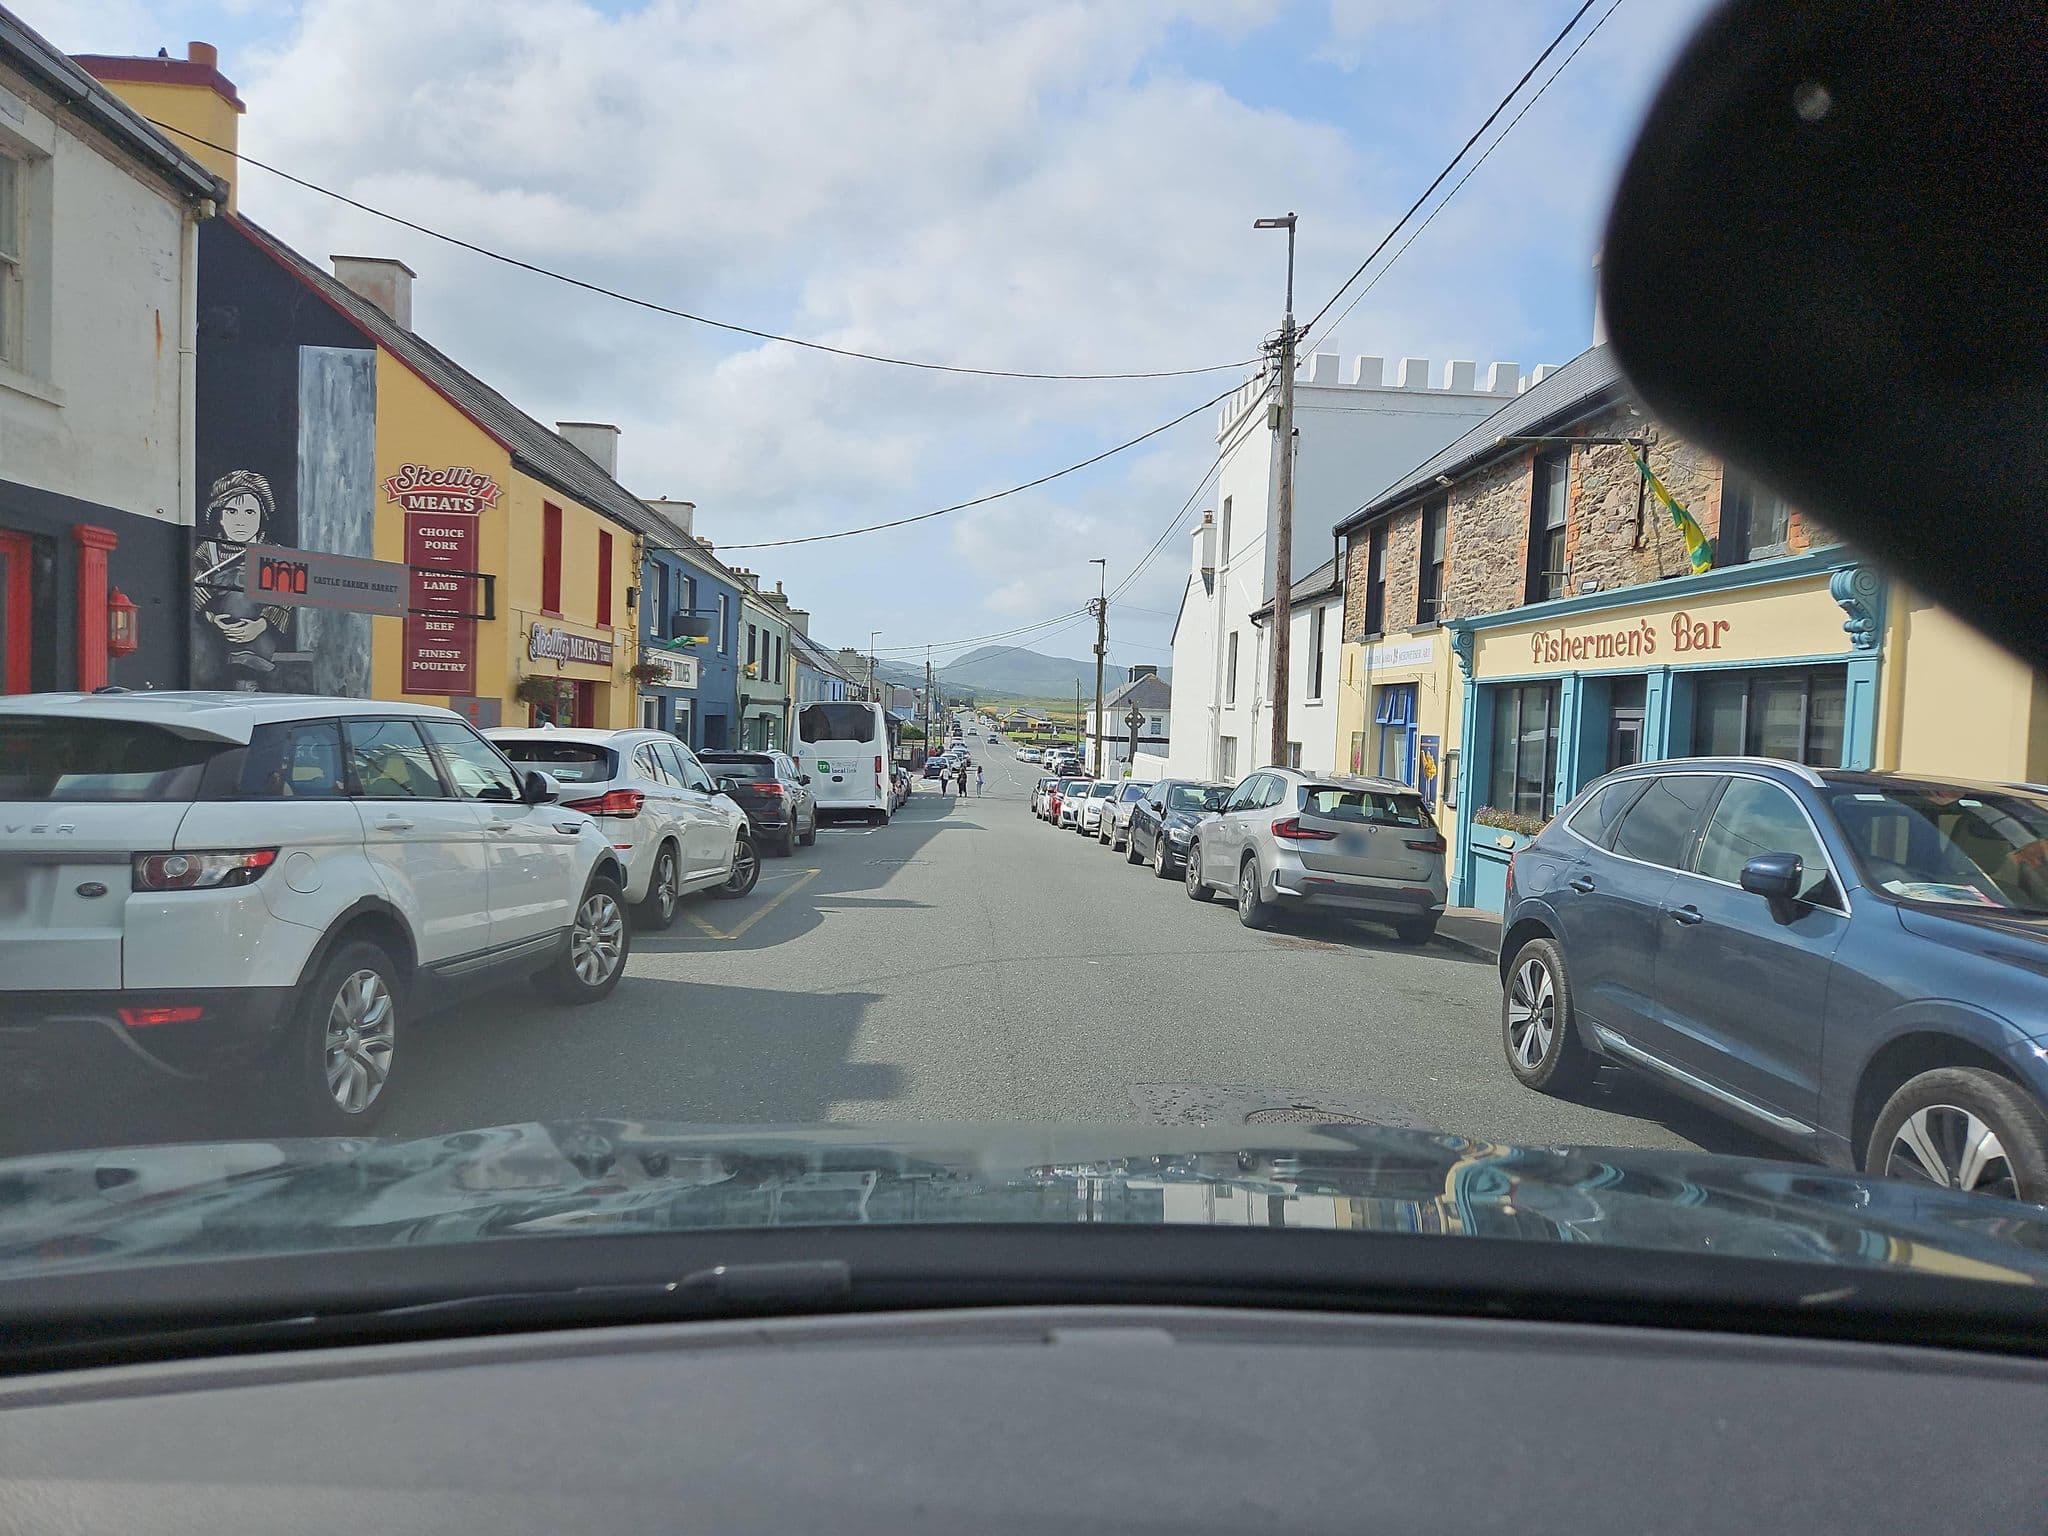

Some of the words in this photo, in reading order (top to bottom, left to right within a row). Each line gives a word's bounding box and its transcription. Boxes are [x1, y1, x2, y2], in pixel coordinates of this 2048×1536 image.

[396, 463, 490, 497] Skellig
[408, 495, 475, 512] MEATS
[418, 528, 465, 538] CHOICE
[424, 540, 459, 551] PORK
[313, 576, 341, 587] CASTLE
[371, 583, 399, 593] MARKET
[423, 581, 459, 591] LAMB
[424, 621, 456, 631] BEEF
[1530, 618, 1657, 664] Fishermen's
[1671, 611, 1731, 652] Bar
[418, 648, 461, 659] FINEST
[570, 637, 598, 661] MEATS
[411, 661, 467, 672] POULTRY
